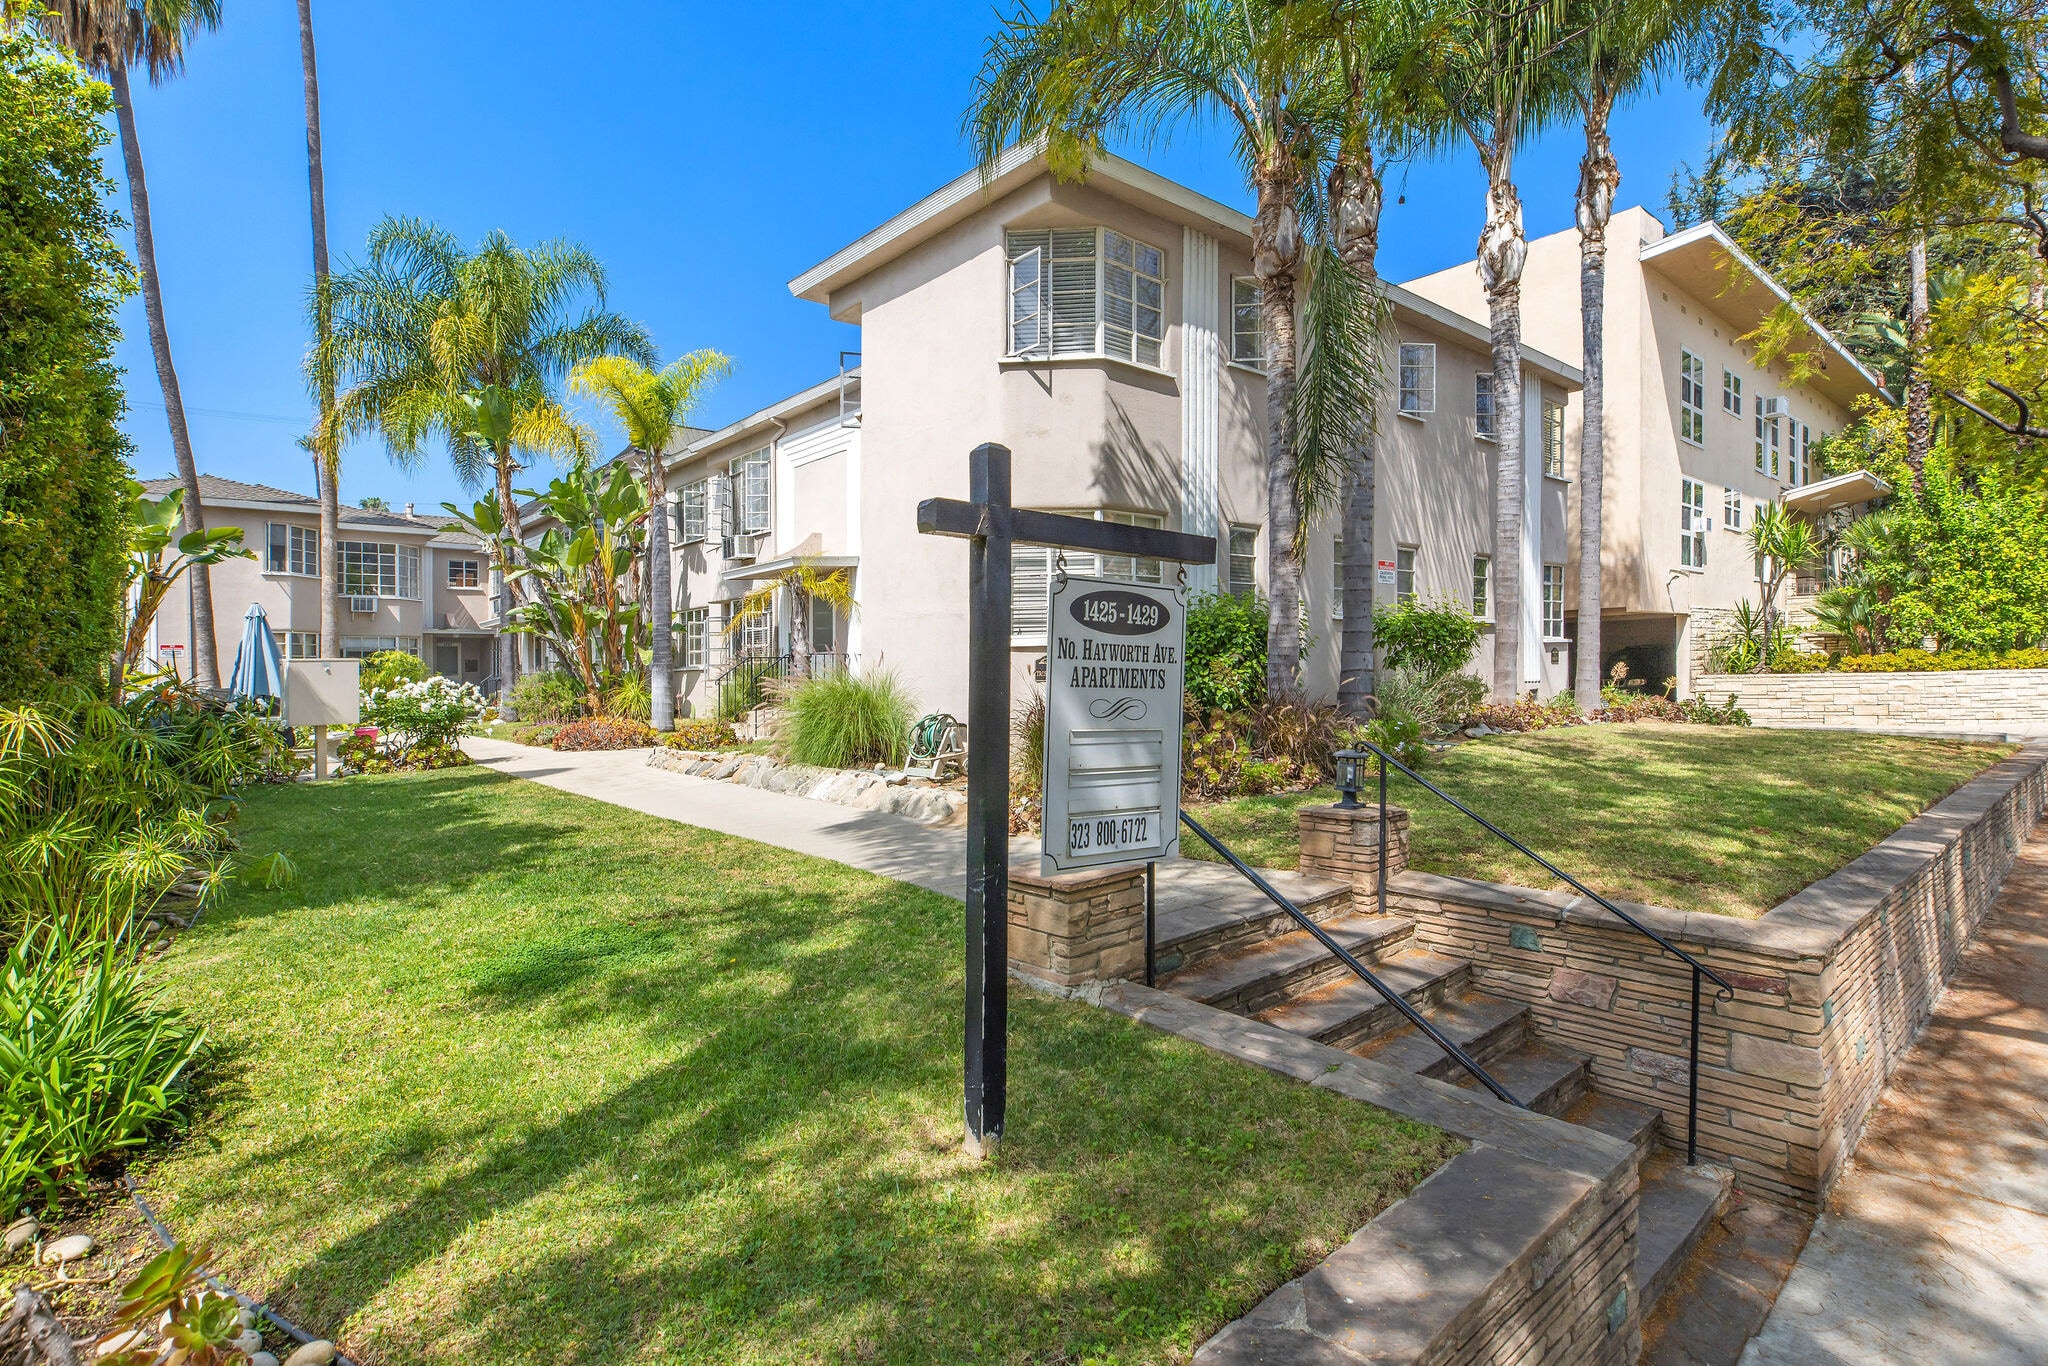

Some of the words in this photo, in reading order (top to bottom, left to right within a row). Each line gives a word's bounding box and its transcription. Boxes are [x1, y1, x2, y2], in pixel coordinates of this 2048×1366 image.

[1057, 637, 1078, 660] NO.
[1082, 639, 1150, 663] HAYWORTH
[1152, 643, 1178, 664] AVE.
[1070, 666, 1166, 690] APARTMENTS
[1071, 822, 1090, 849] 323
